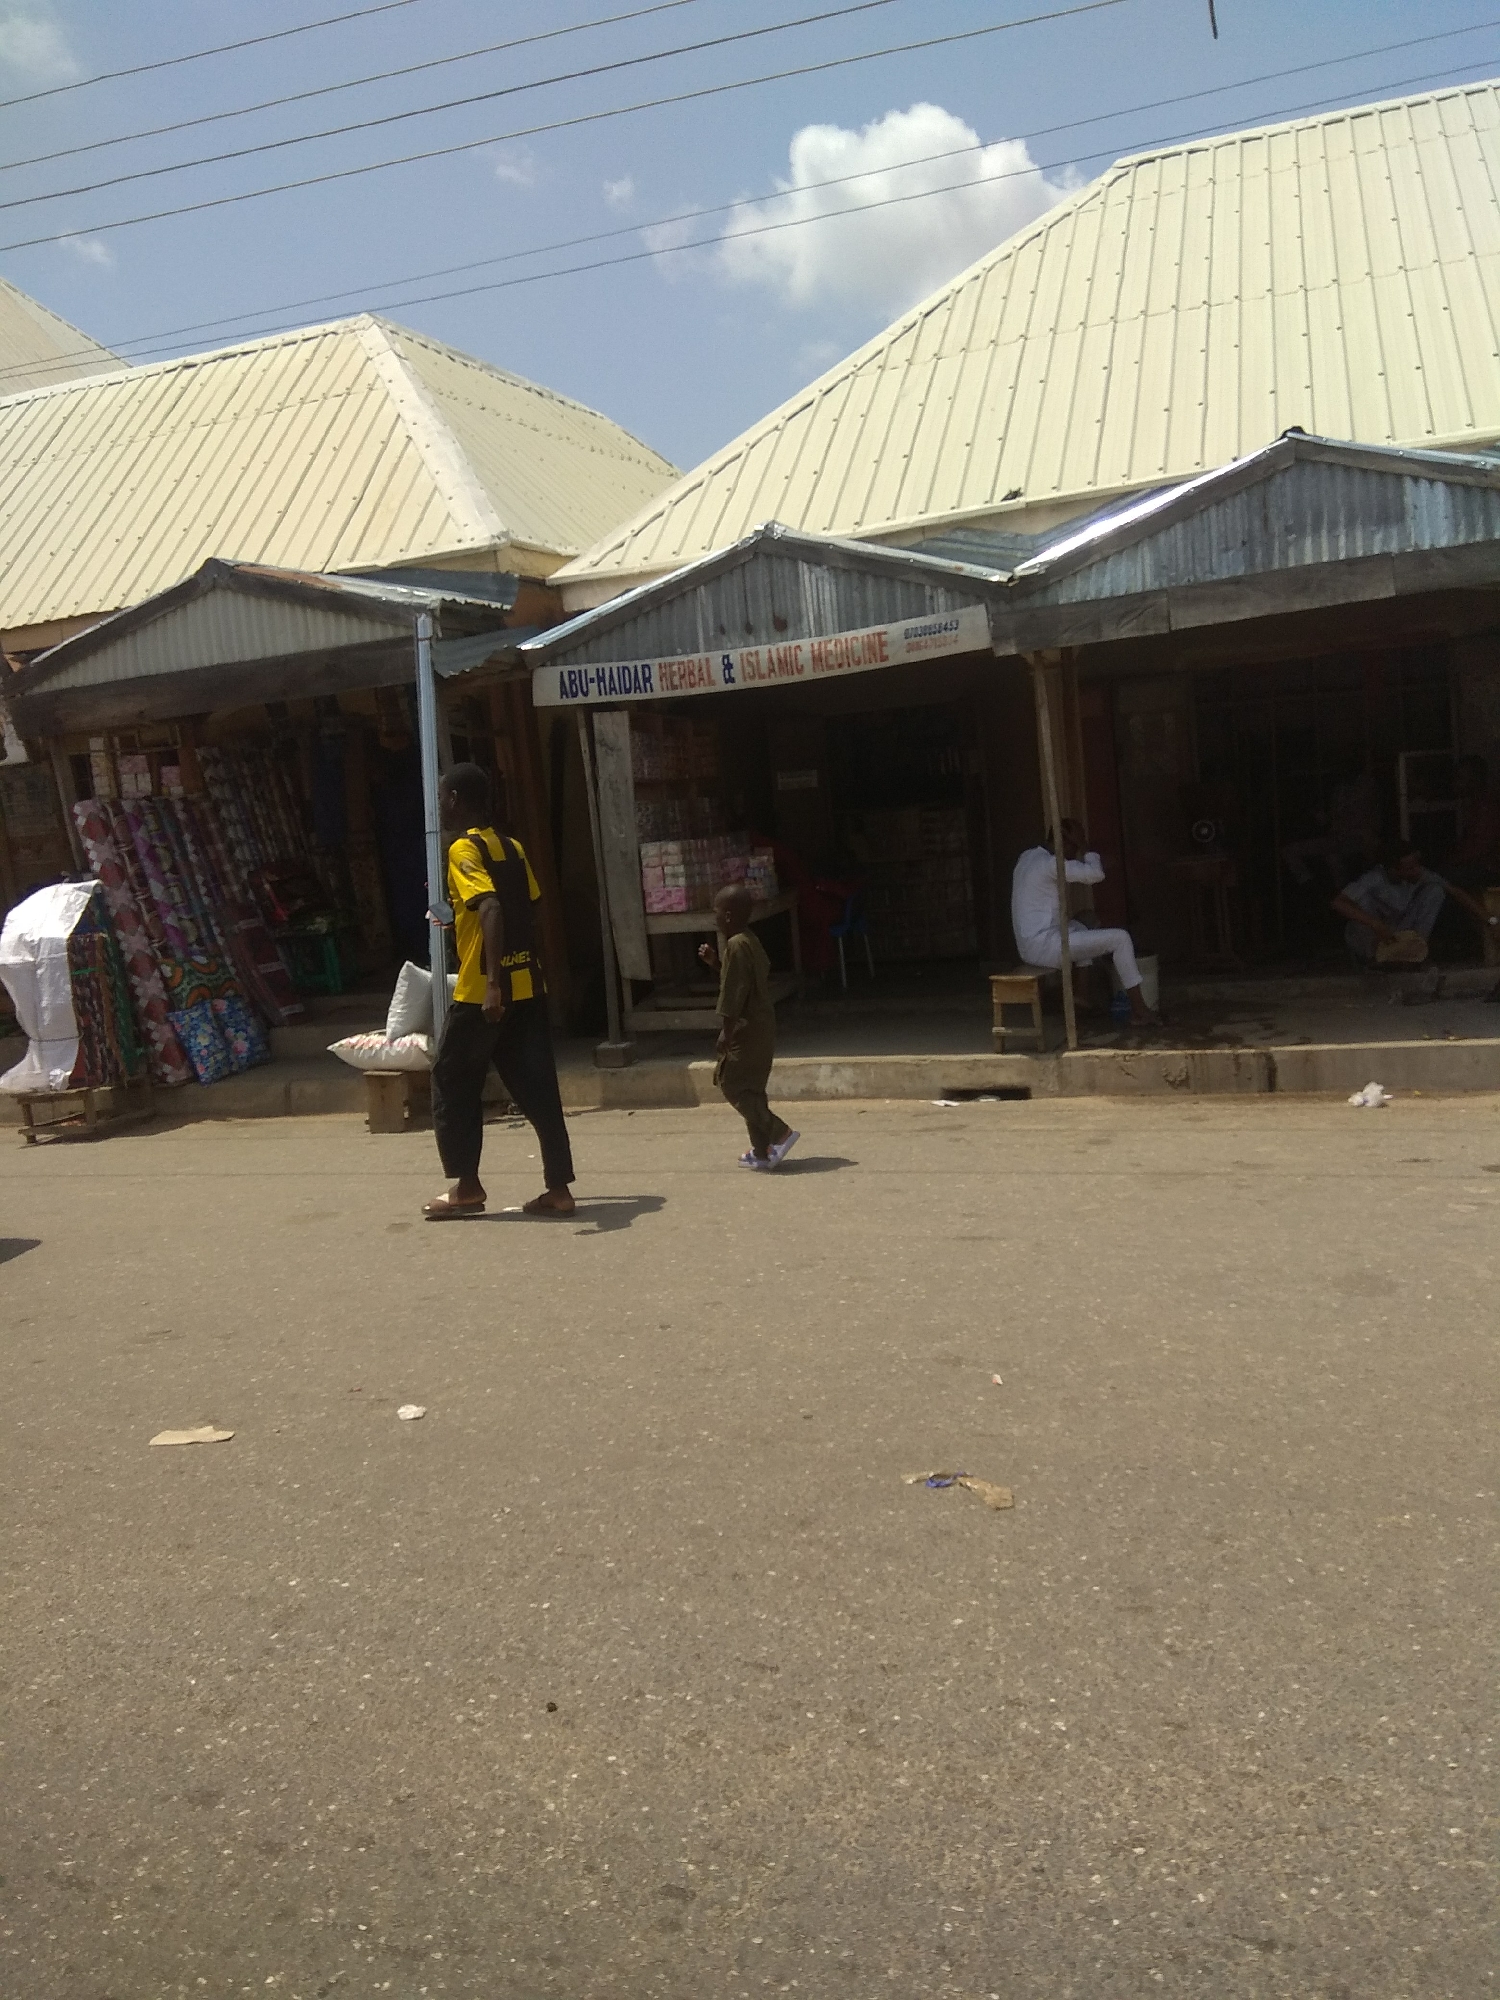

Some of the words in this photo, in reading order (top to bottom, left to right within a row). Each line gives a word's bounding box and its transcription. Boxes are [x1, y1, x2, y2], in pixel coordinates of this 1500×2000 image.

[559, 663, 654, 700] ABU-HAIDAR
[657, 656, 717, 692] HERBAL
[721, 653, 736, 685] &
[738, 644, 805, 682] ISLAMIC
[810, 630, 889, 673] MEDICINE
